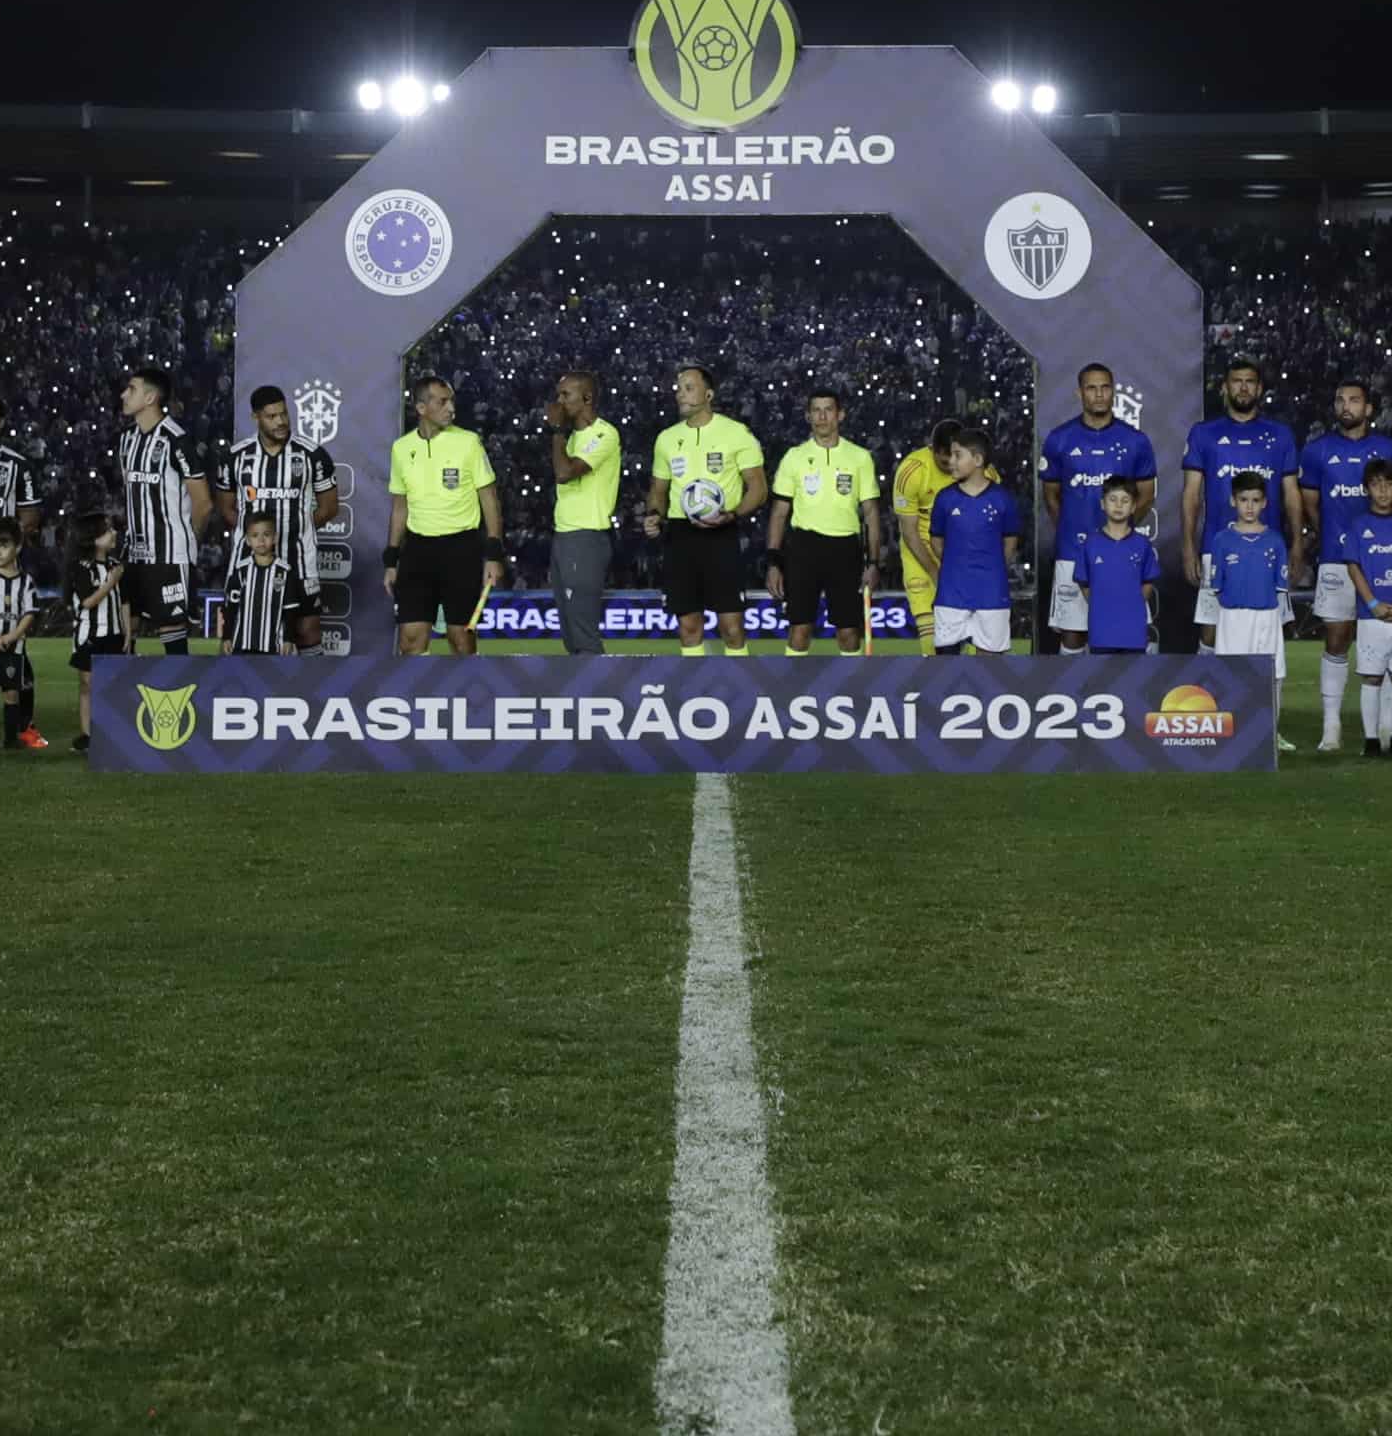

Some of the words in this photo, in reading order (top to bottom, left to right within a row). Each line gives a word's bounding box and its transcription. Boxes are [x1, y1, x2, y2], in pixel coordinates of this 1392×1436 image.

[545, 127, 895, 165] BRASILEIRÃO
[364, 200, 436, 227] CRUZEIRO
[356, 234, 402, 284] ESPORTE
[410, 236, 441, 281] CLUBE
[256, 488, 299, 499] BETANO
[211, 684, 730, 740] BRASILEIRÃO
[939, 694, 1126, 740] 2023
[1162, 738, 1217, 746] ATACADISTA
